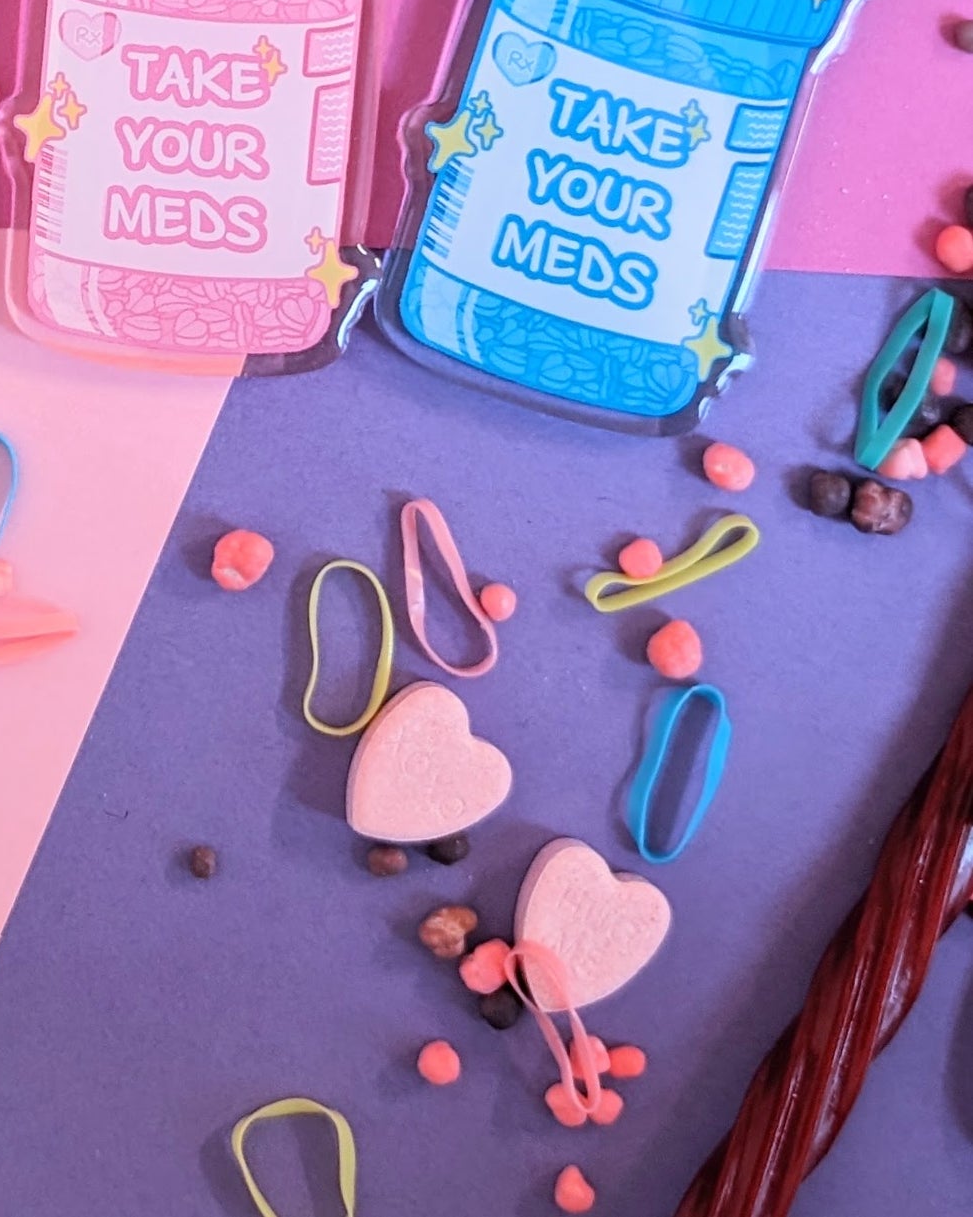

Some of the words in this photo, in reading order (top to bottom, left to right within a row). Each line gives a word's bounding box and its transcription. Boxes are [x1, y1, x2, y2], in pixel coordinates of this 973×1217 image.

[123, 47, 267, 107] TAKE
[118, 120, 267, 179] YOUR
[550, 86, 691, 164] TAKE
[105, 188, 264, 250] MEDS
[529, 153, 670, 239] YOUR
[495, 218, 656, 308] MEDS
